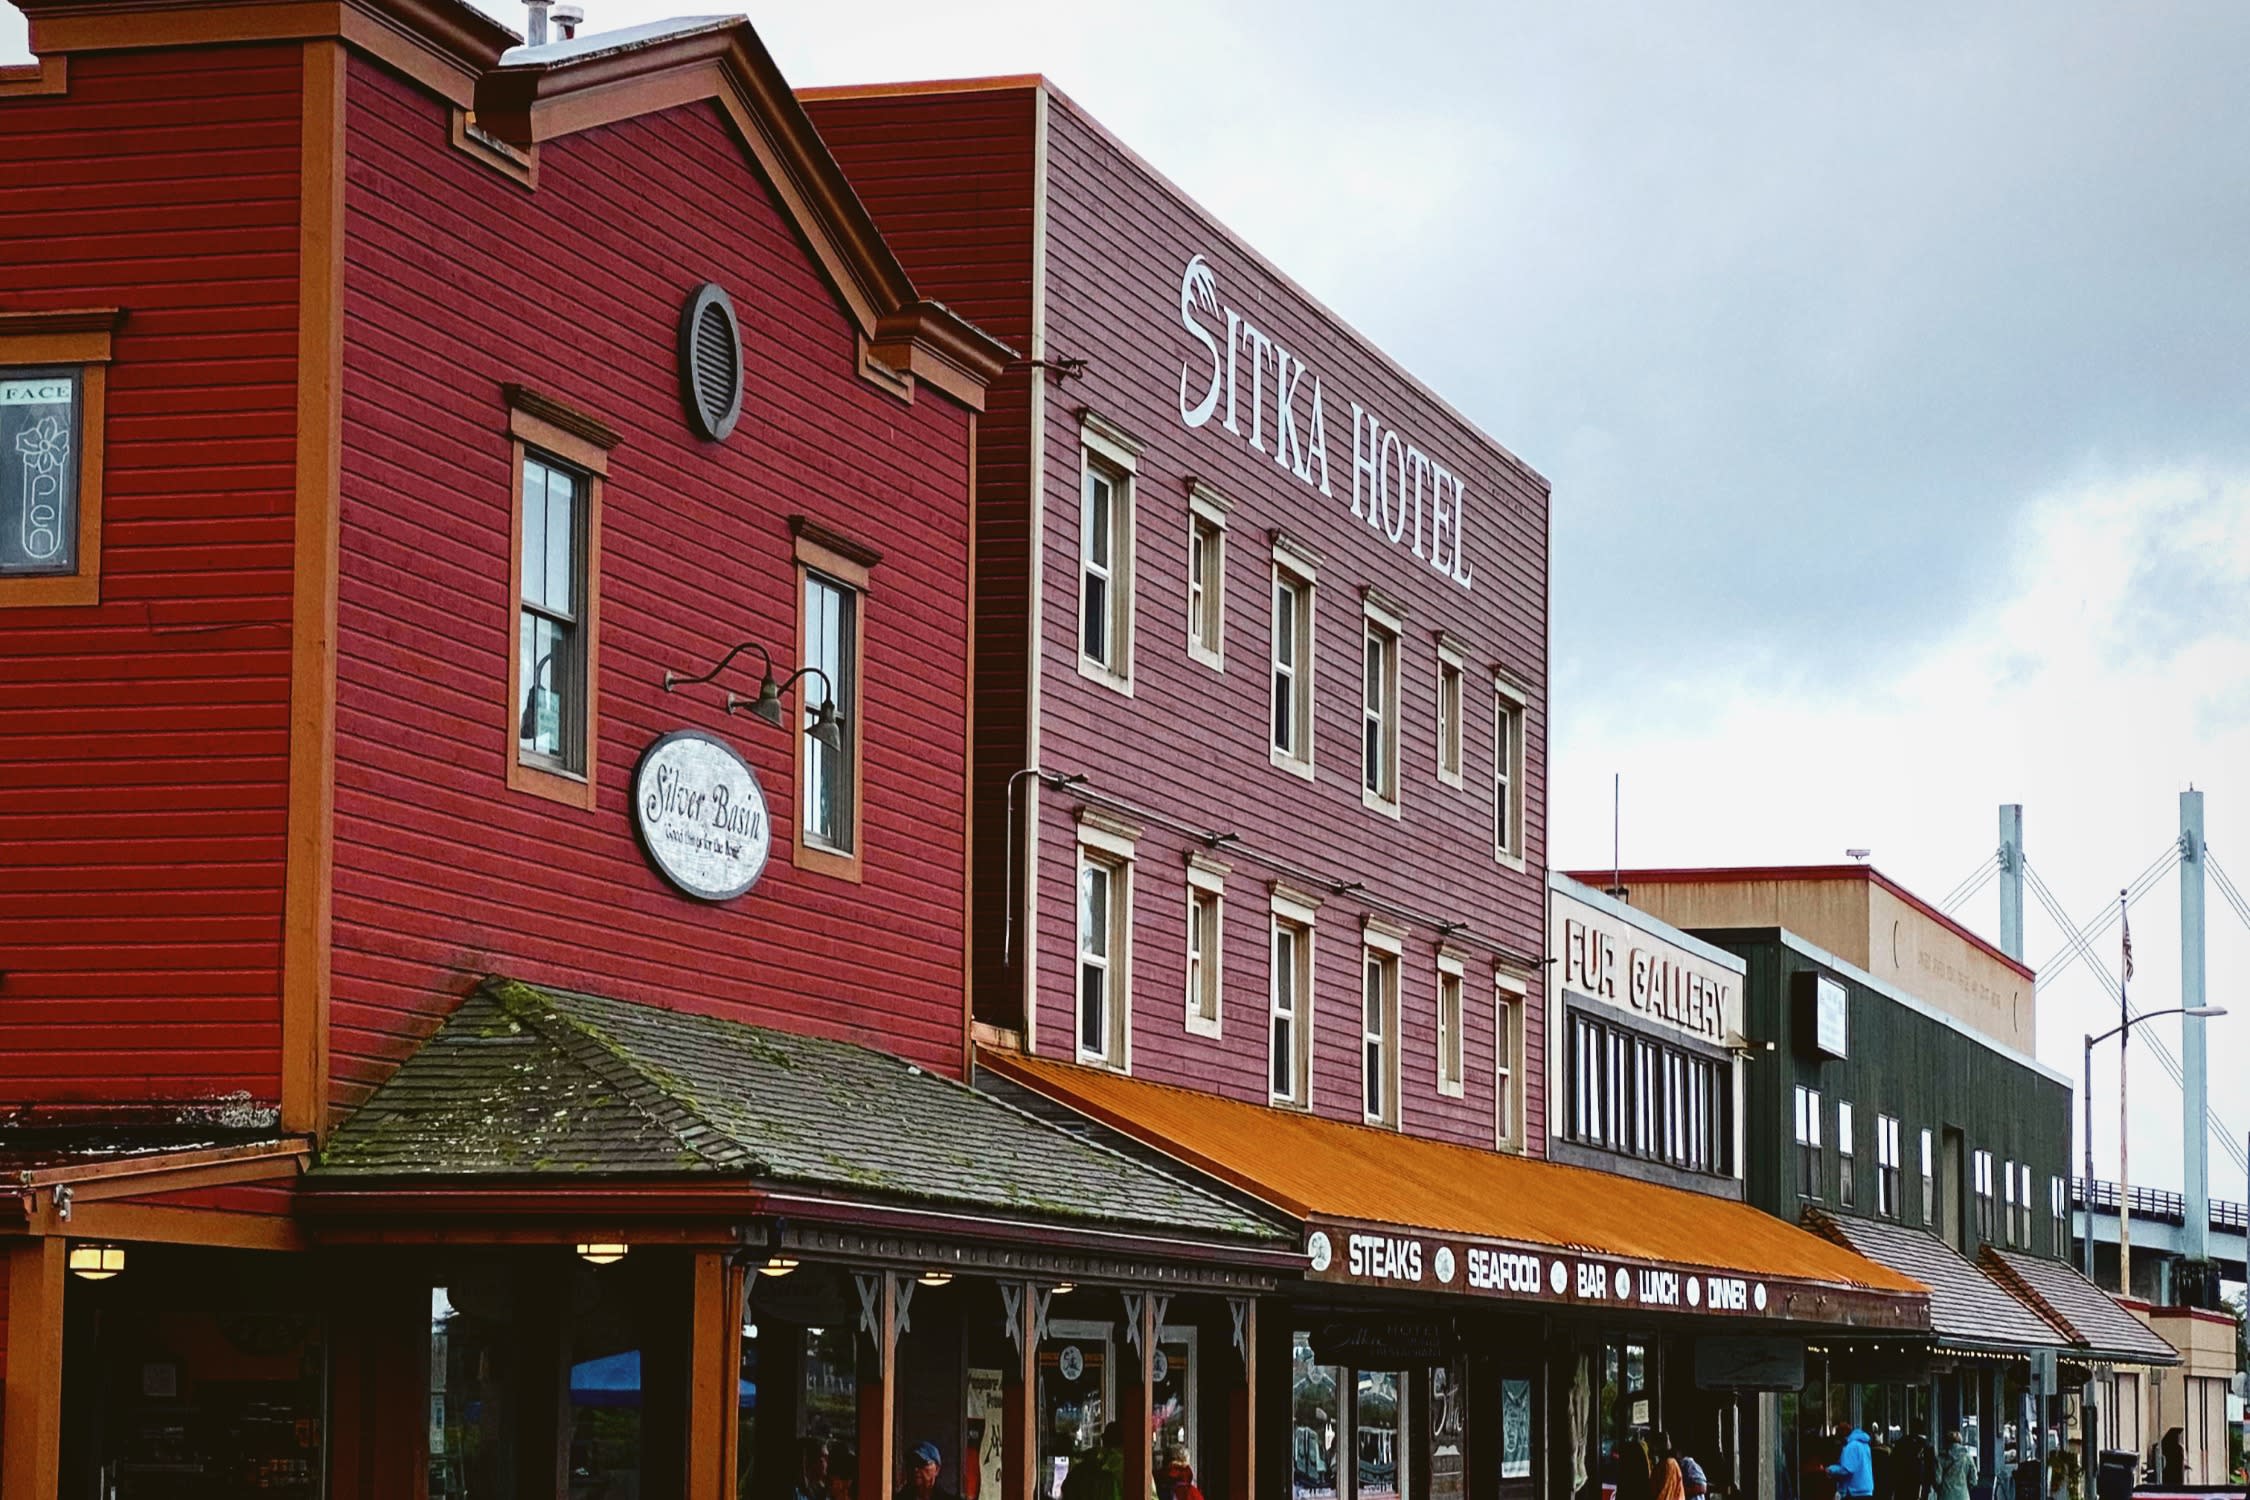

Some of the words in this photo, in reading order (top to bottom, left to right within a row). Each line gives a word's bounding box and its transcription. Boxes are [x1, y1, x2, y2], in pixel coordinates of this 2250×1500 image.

[1179, 253, 1333, 498] SITKA
[1349, 400, 1473, 590] HOTEL
[646, 763, 706, 823] Silver
[712, 784, 760, 840] Basin
[1565, 918, 1616, 999] FUR
[1629, 947, 1730, 1040] GALLERY
[1349, 1234, 1422, 1281] STEAKS
[1467, 1248, 1541, 1293] SEAFOOD
[1577, 1262, 1607, 1299] BAR
[1639, 1270, 1679, 1305] LUNCH
[1707, 1277, 1747, 1310] DINNER
